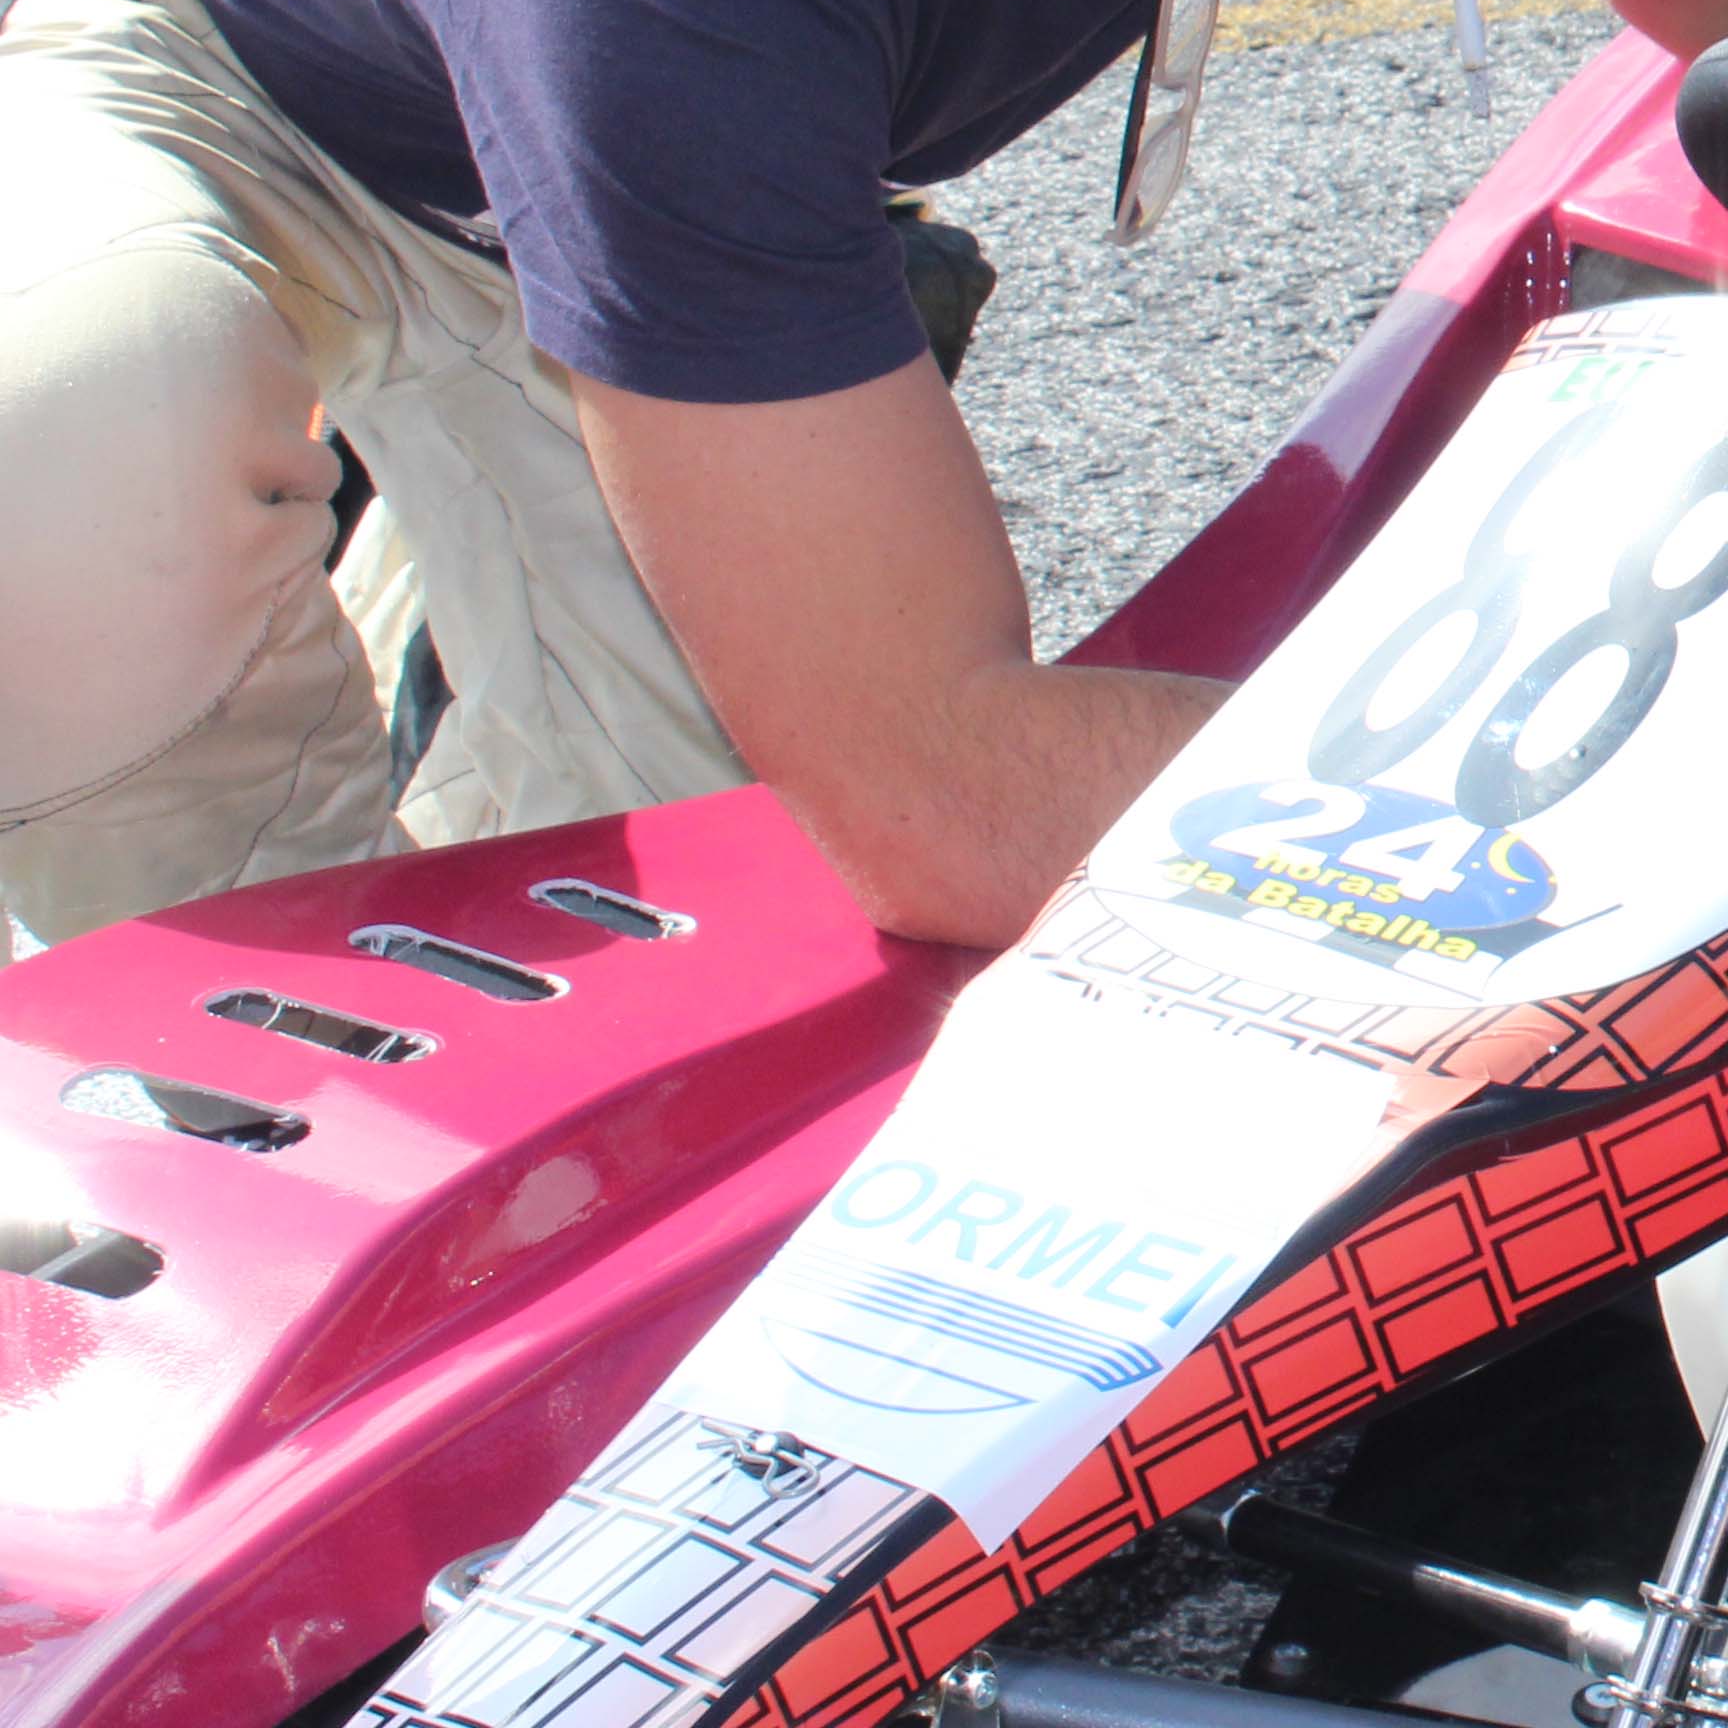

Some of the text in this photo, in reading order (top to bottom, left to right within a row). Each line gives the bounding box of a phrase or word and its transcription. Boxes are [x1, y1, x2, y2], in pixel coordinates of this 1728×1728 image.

[1210, 777, 1487, 903] 24
[1253, 848, 1401, 905] horas
[1163, 859, 1479, 962] da Batalha
[831, 1159, 1239, 1330] ORMEI
